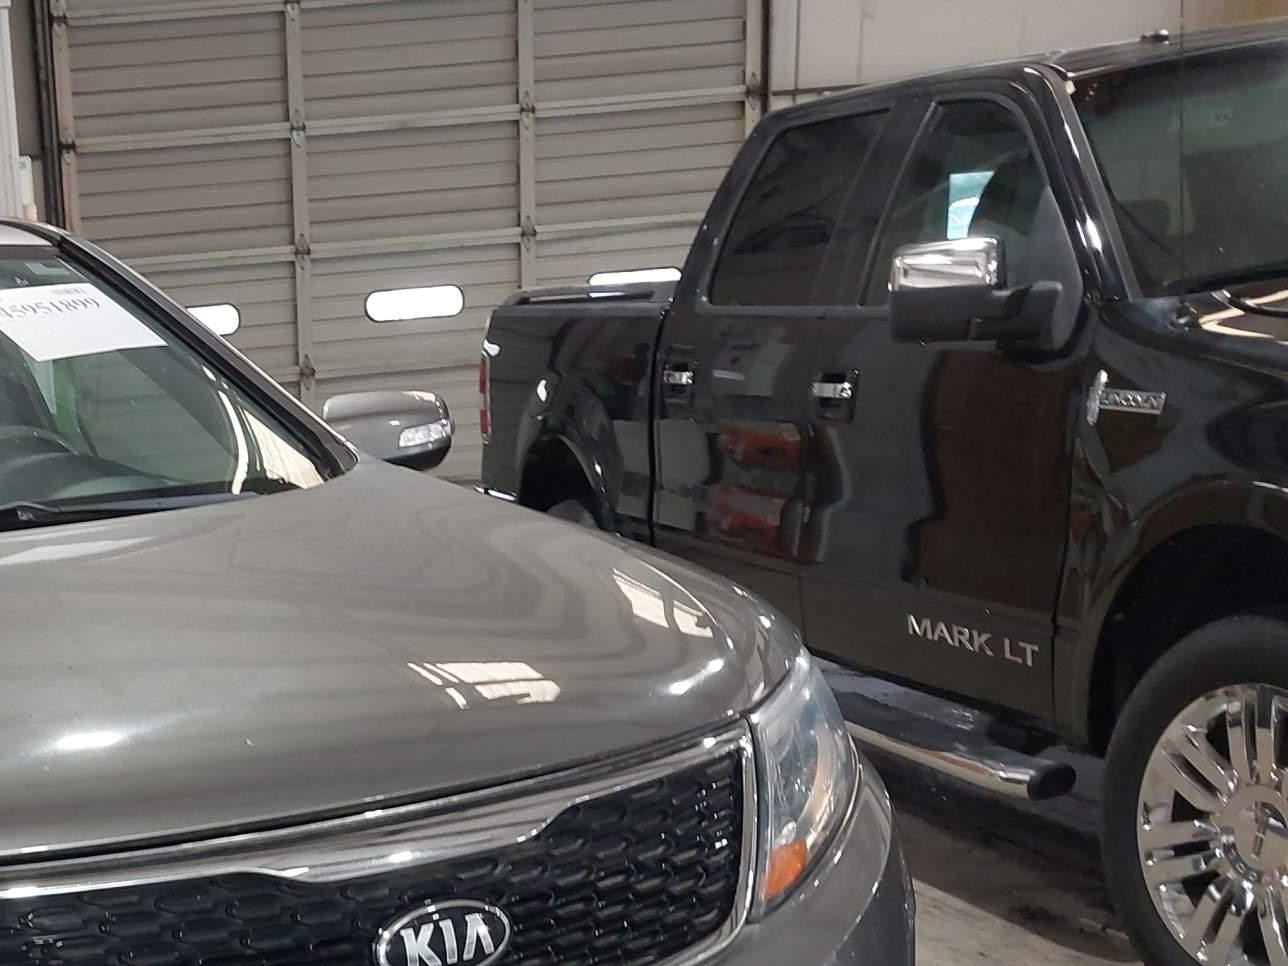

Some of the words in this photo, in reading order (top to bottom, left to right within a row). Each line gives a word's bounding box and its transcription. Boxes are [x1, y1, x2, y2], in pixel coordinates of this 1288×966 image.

[0, 297, 101, 319] 45951899
[906, 613, 994, 657] MARK
[1003, 637, 1040, 667] LT
